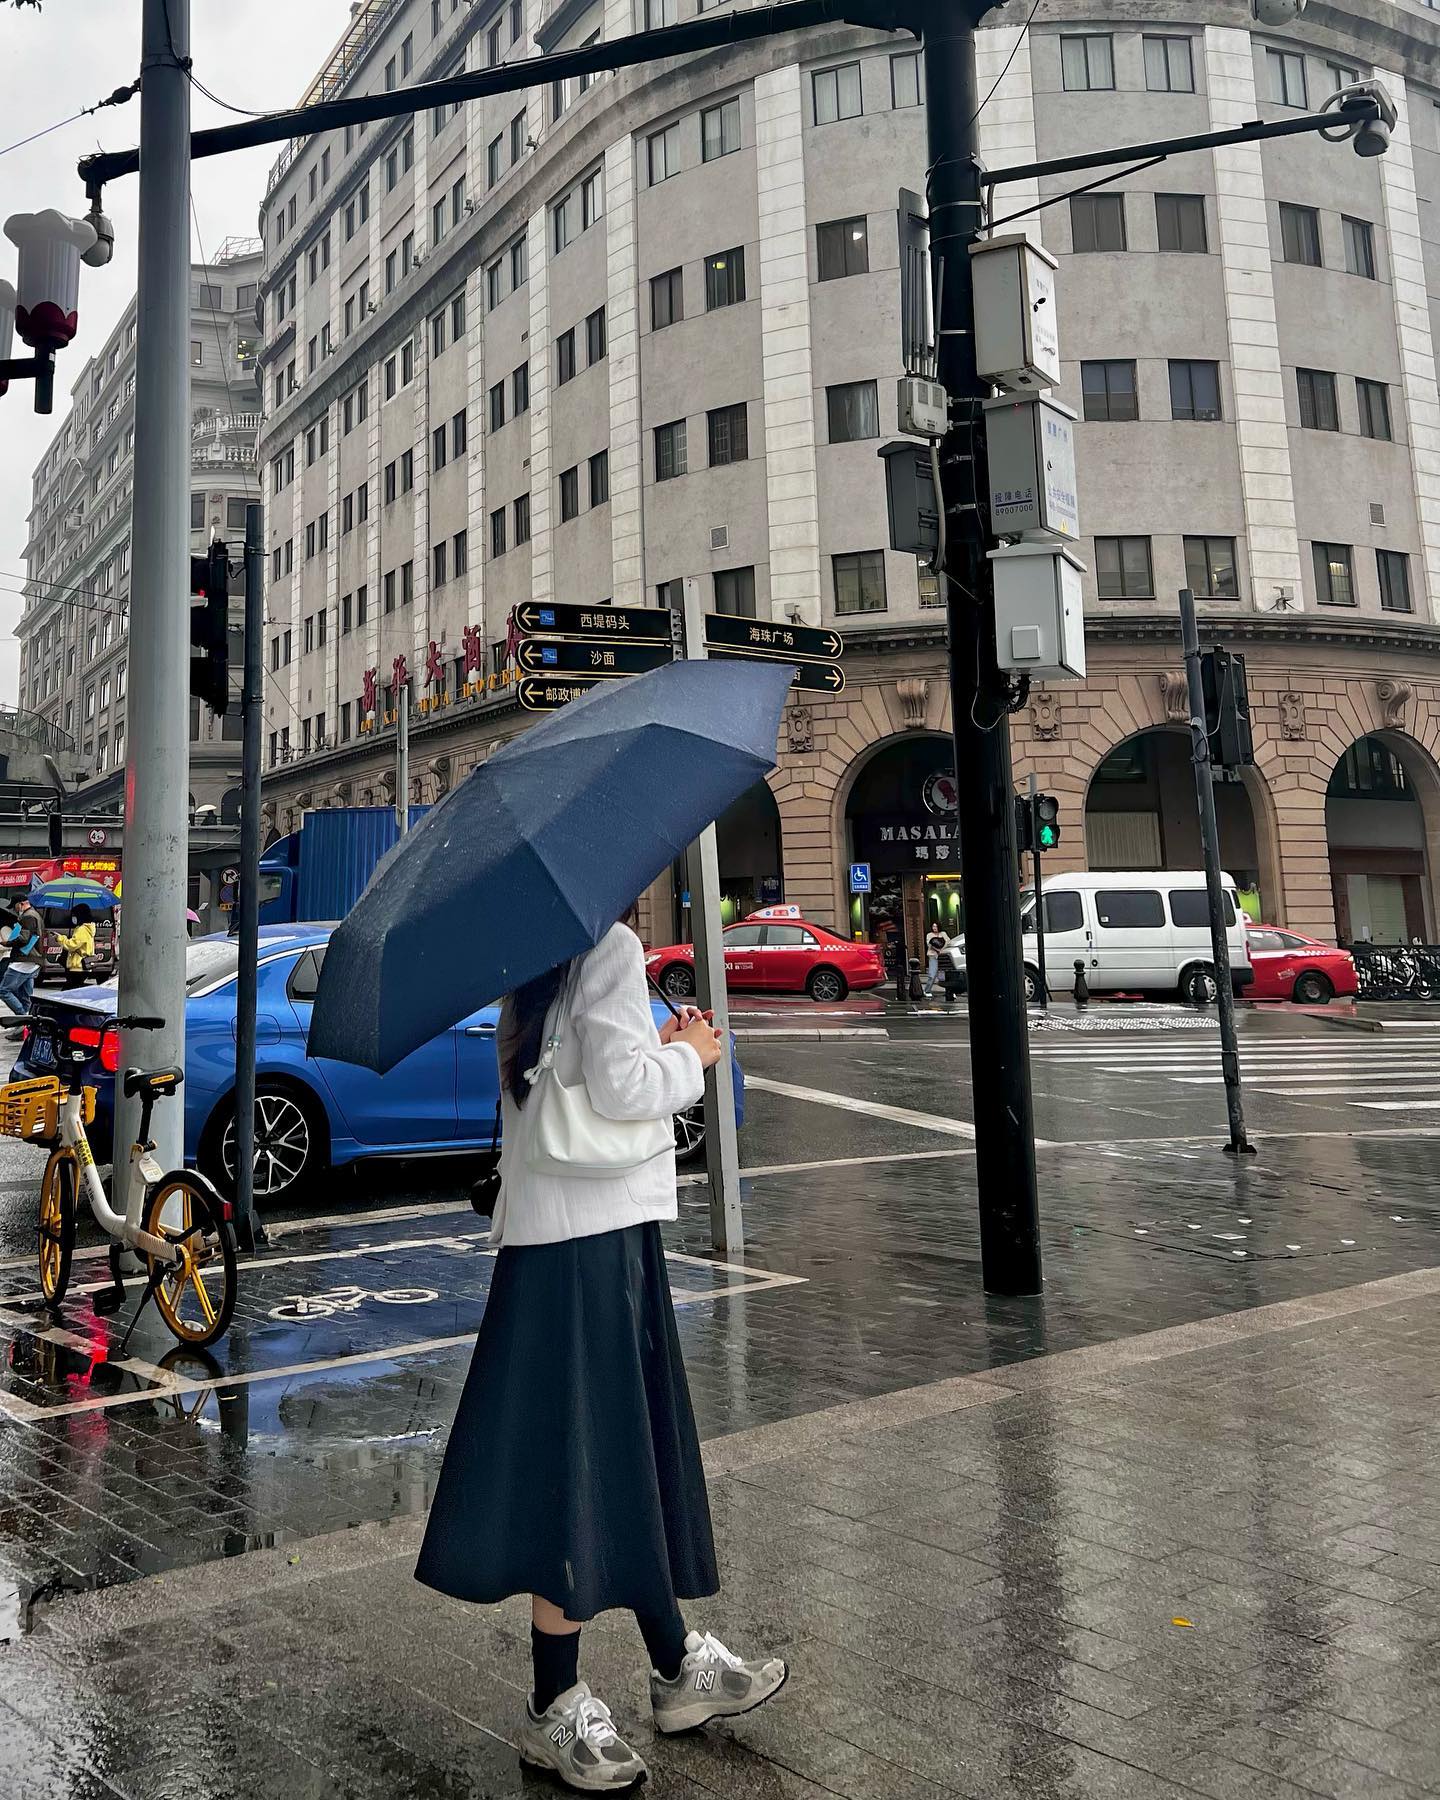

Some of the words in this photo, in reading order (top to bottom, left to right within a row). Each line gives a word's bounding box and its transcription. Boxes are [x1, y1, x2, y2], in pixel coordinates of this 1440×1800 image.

[996, 504, 1033, 516] 89007000
[580, 613, 630, 630] 西堤码头
[749, 627, 794, 646] 海珠广场
[590, 651, 615, 667] 沙面
[915, 845, 960, 860] 玛莎
[695, 1671, 715, 1690] N
[551, 1724, 573, 1747] N
